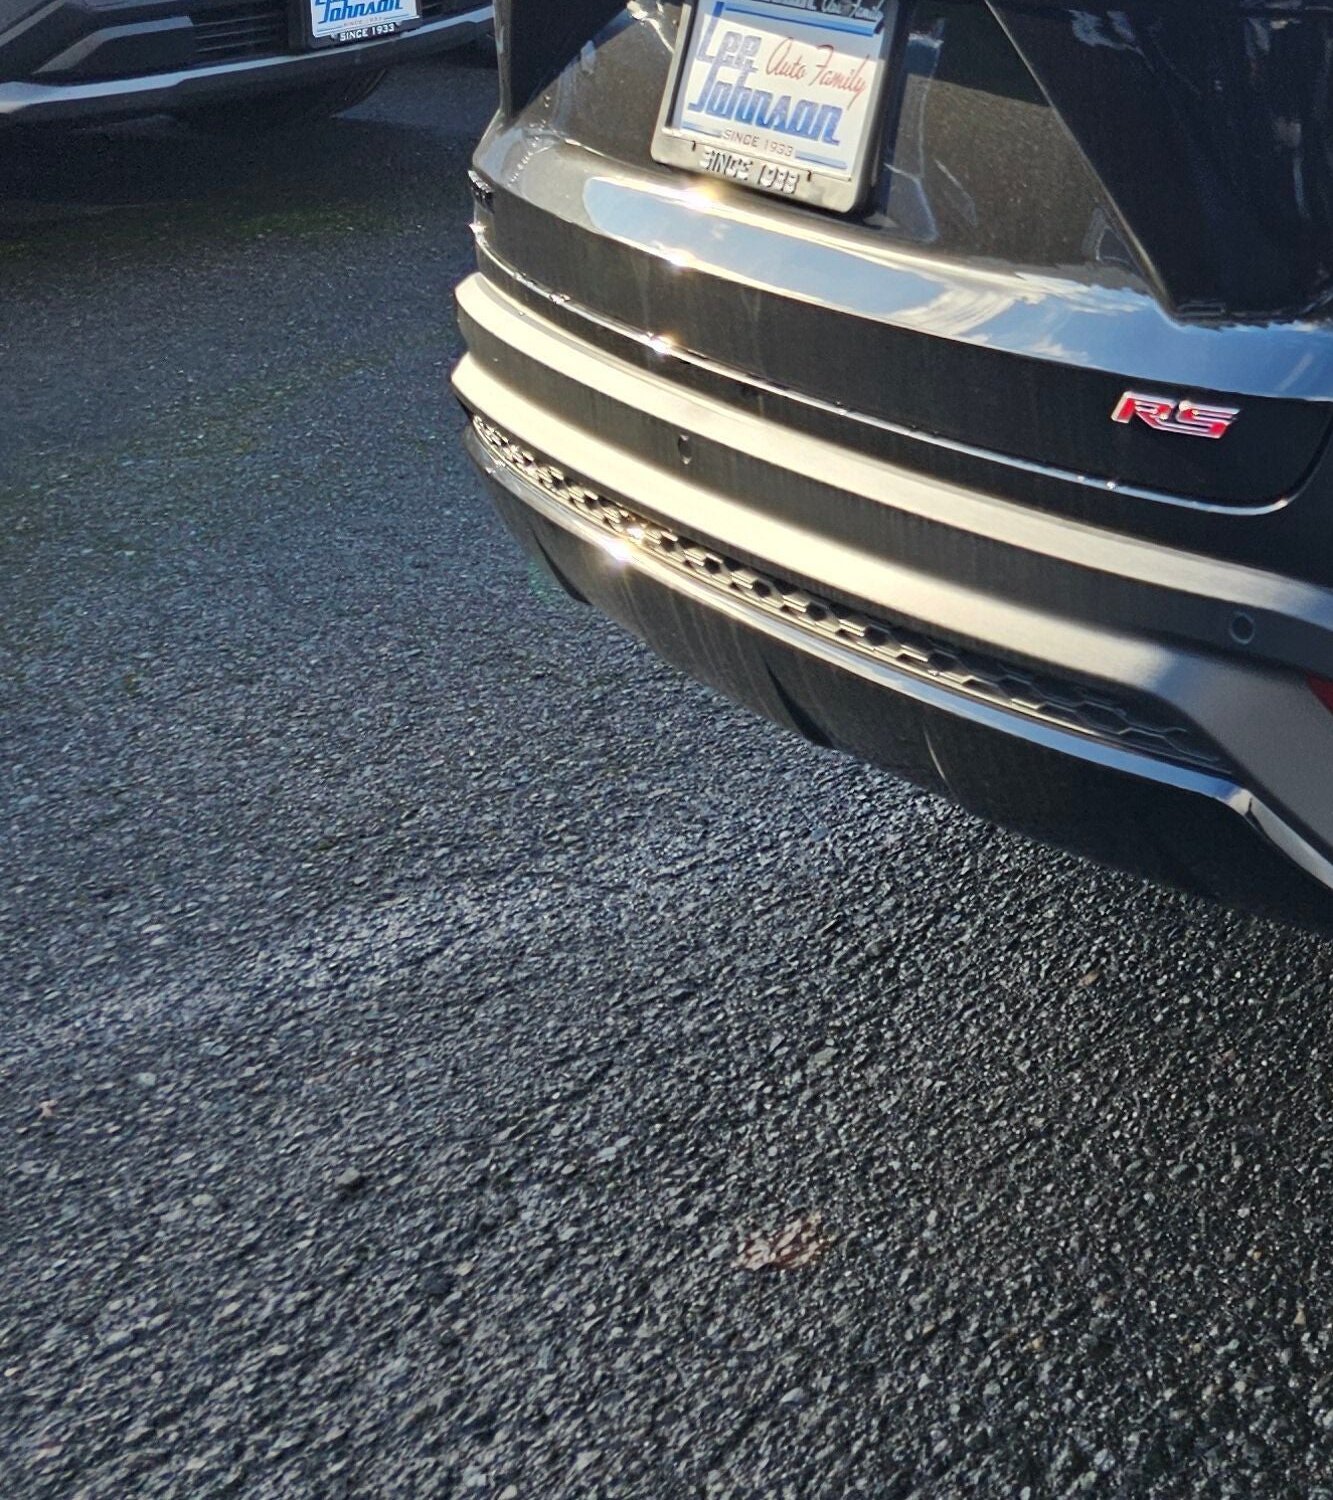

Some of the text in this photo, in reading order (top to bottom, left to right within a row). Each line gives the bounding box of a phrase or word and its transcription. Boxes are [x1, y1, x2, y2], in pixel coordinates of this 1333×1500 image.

[340, 22, 395, 41] SINCE 1933
[697, 1, 870, 110] Lee Auto Family
[687, 60, 843, 146] Johnson
[722, 129, 795, 157] SINCE 1933
[1111, 391, 1241, 439] RS
